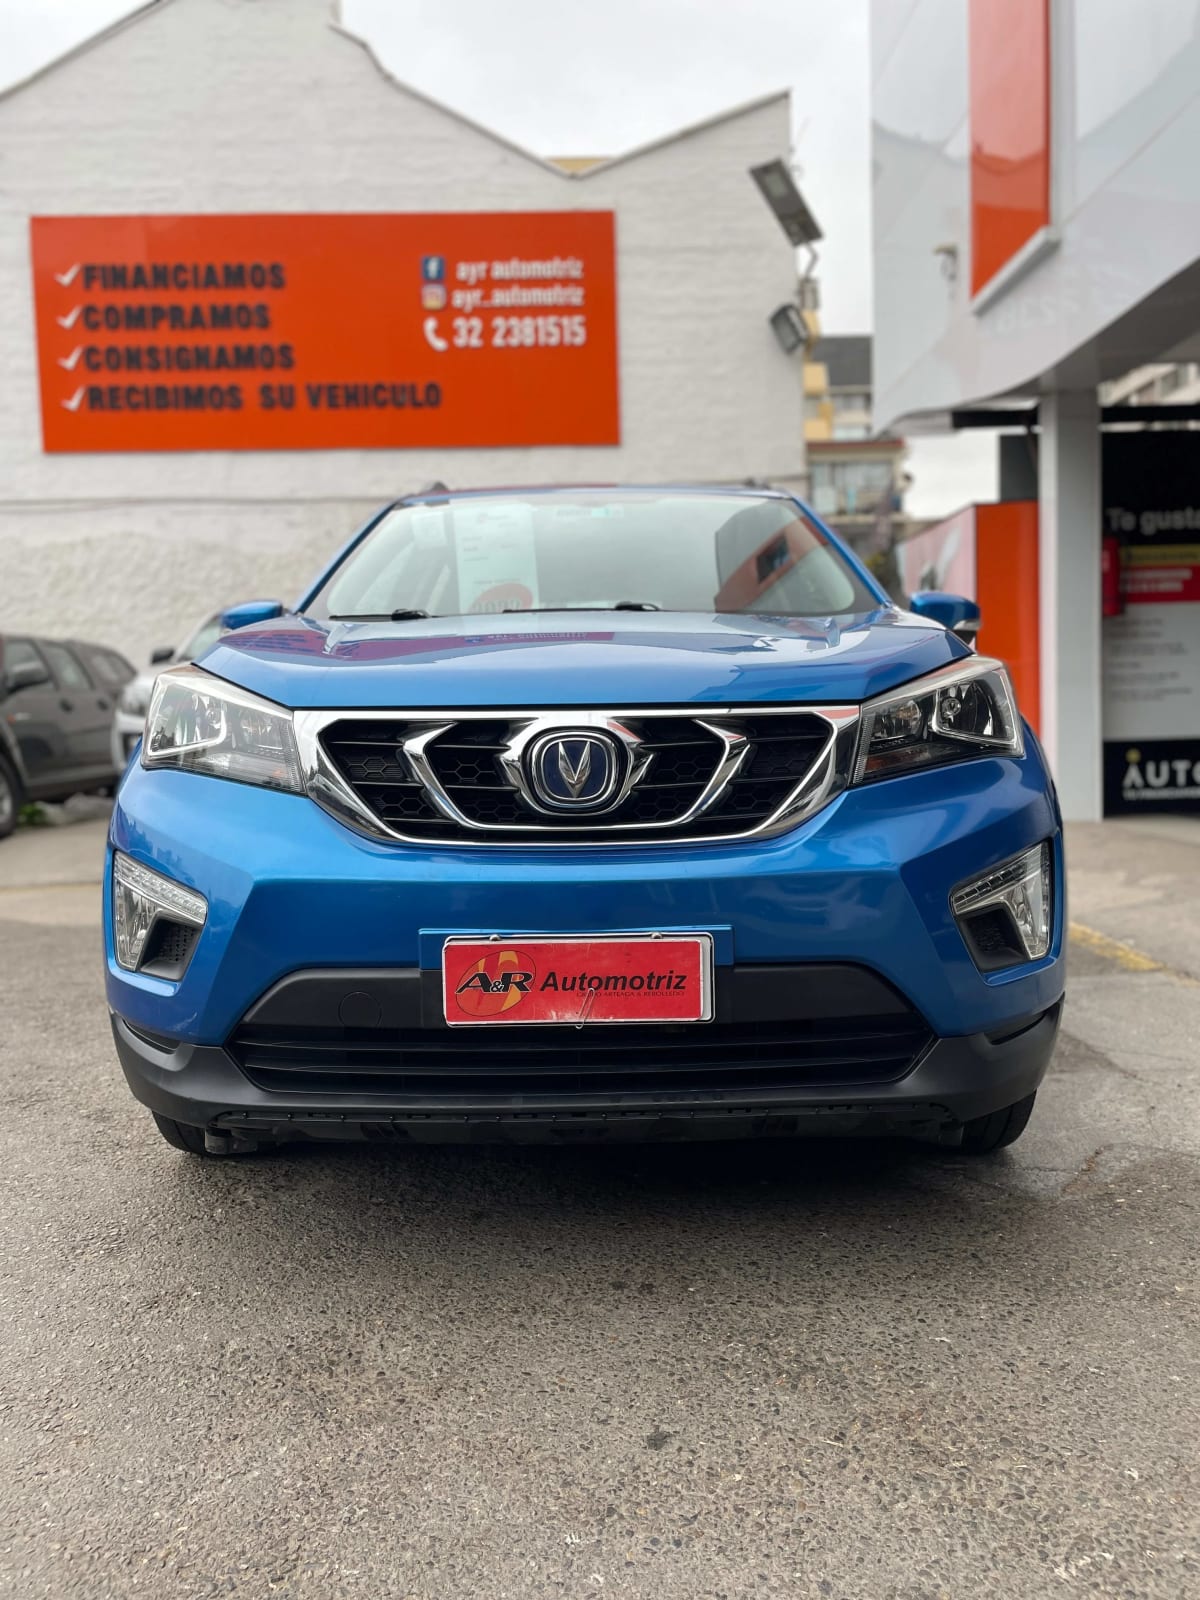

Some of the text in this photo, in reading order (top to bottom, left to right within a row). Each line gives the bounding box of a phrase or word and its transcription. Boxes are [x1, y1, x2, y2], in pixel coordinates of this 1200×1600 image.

[83, 264, 285, 290] FINANCIAMOS
[456, 262, 487, 285] ayr
[83, 305, 269, 330] COMPRAMOS
[453, 316, 586, 347] 32 2381515
[84, 346, 294, 371] CONSIGNAMOS
[88, 383, 441, 411] RECIBIMOS SU VEHICULO
[455, 970, 687, 993] A&R Automotriz
